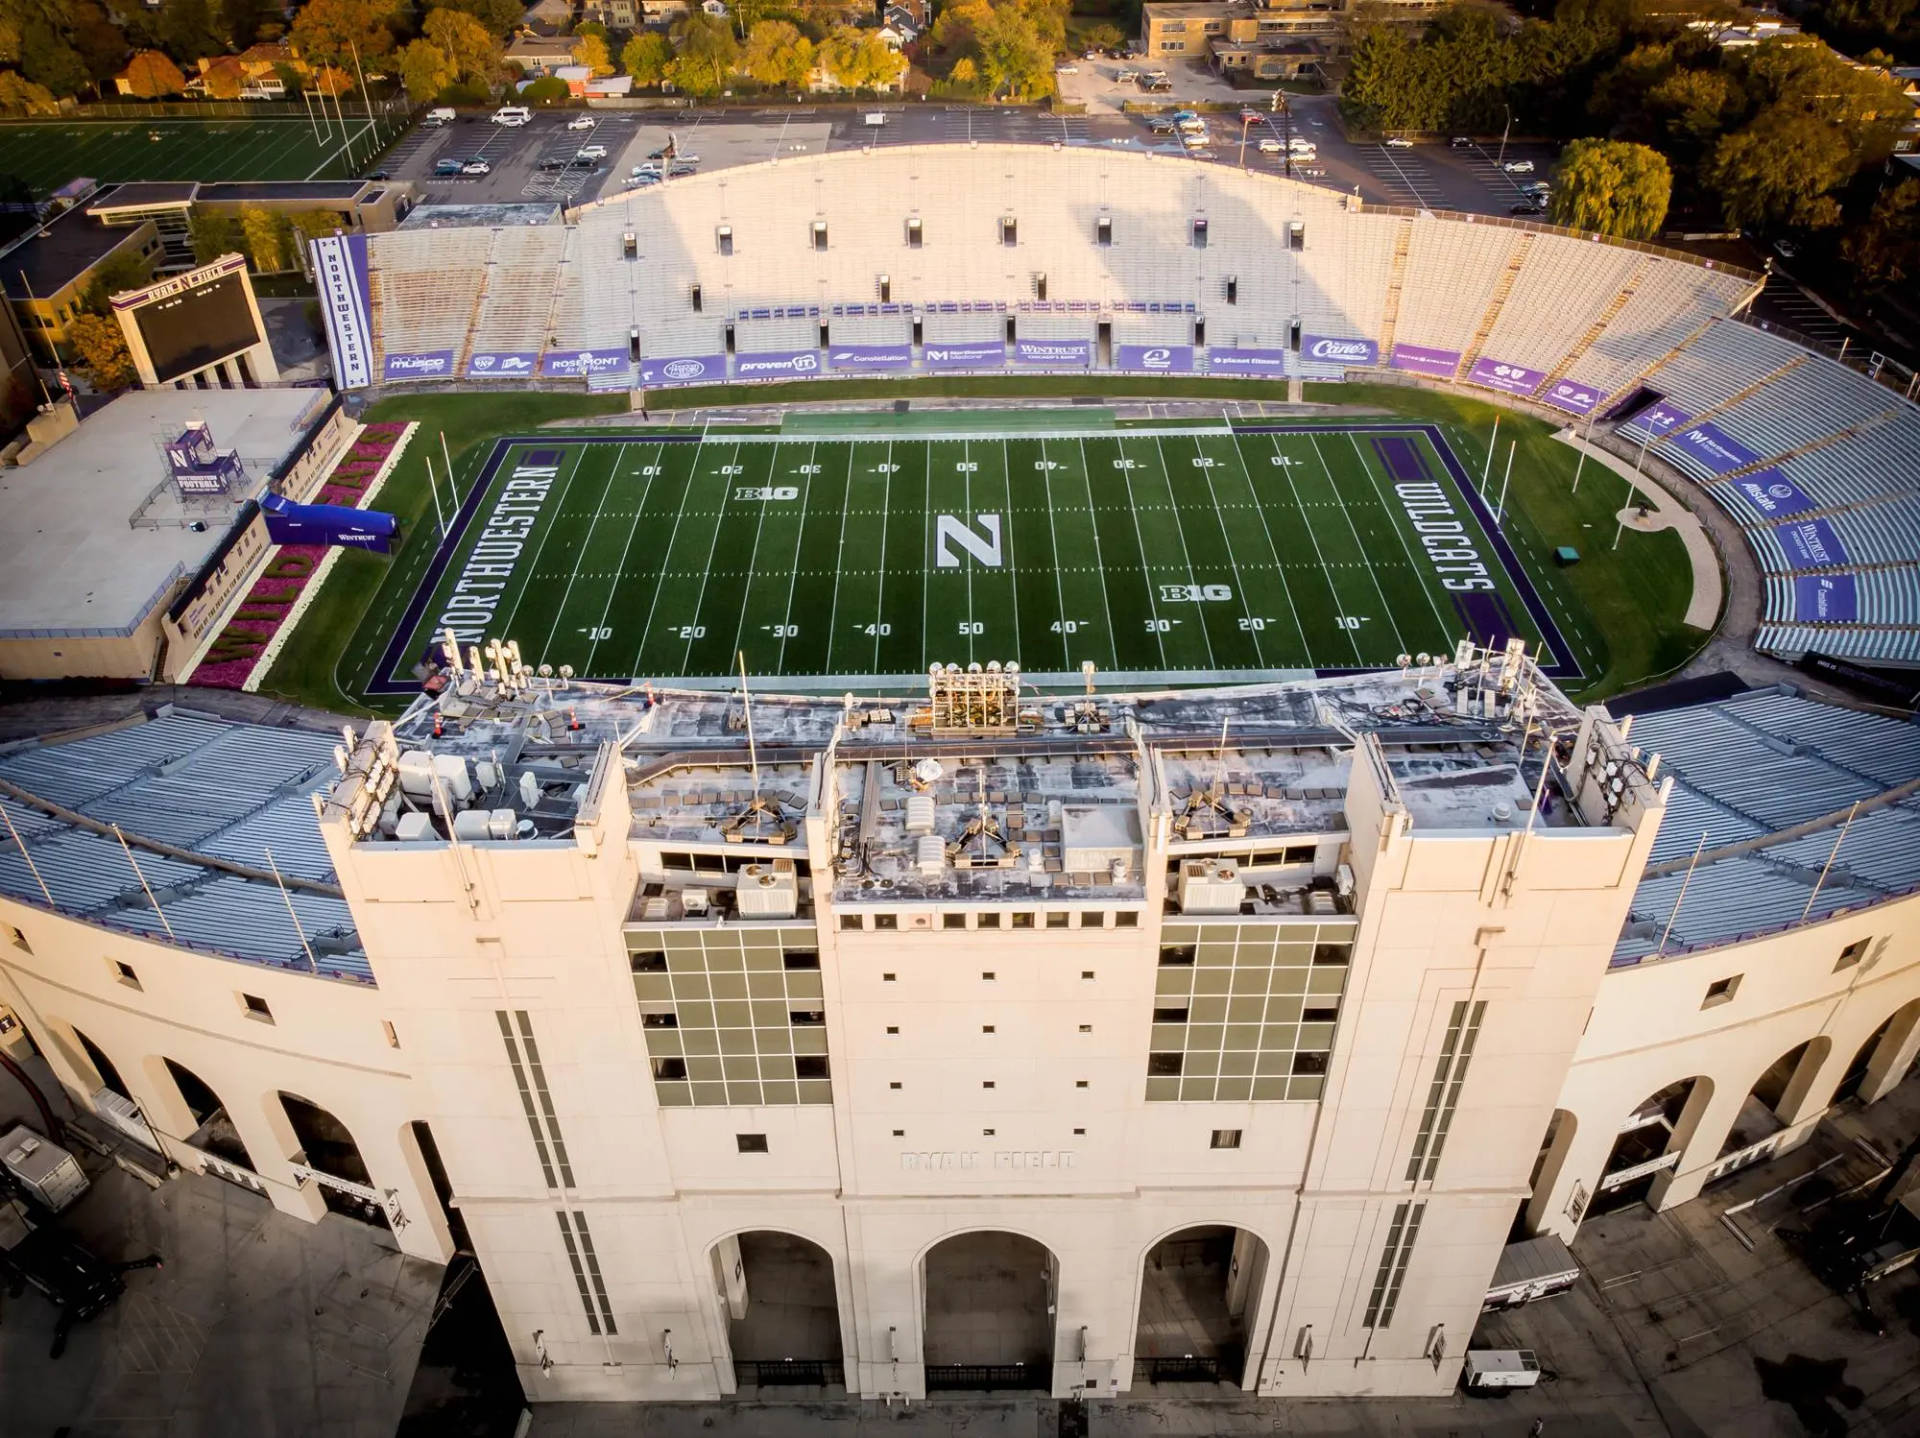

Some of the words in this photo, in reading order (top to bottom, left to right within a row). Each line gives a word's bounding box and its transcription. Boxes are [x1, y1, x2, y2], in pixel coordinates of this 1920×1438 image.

[328, 254, 360, 371] NORTHWESTERN
[1021, 345, 1087, 354] WINTRUST
[1312, 340, 1367, 357] Cane's
[552, 357, 620, 369] ROSEMONT
[740, 360, 792, 372] proven
[169, 449, 188, 468] N
[1742, 483, 1776, 512] Allstate
[936, 514, 1002, 567] N
[1394, 482, 1496, 591] WILDCATS
[1802, 523, 1830, 562] WINTRUST
[430, 466, 559, 644] NORTHWESTERN
[958, 622, 984, 635] 50
[1050, 621, 1077, 634] 40
[1144, 620, 1171, 632] 30
[1238, 618, 1265, 630] 20
[1335, 616, 1360, 629] 10
[589, 627, 613, 640] 10
[680, 626, 706, 639] 20
[773, 624, 799, 637] 30
[864, 623, 891, 636] 40
